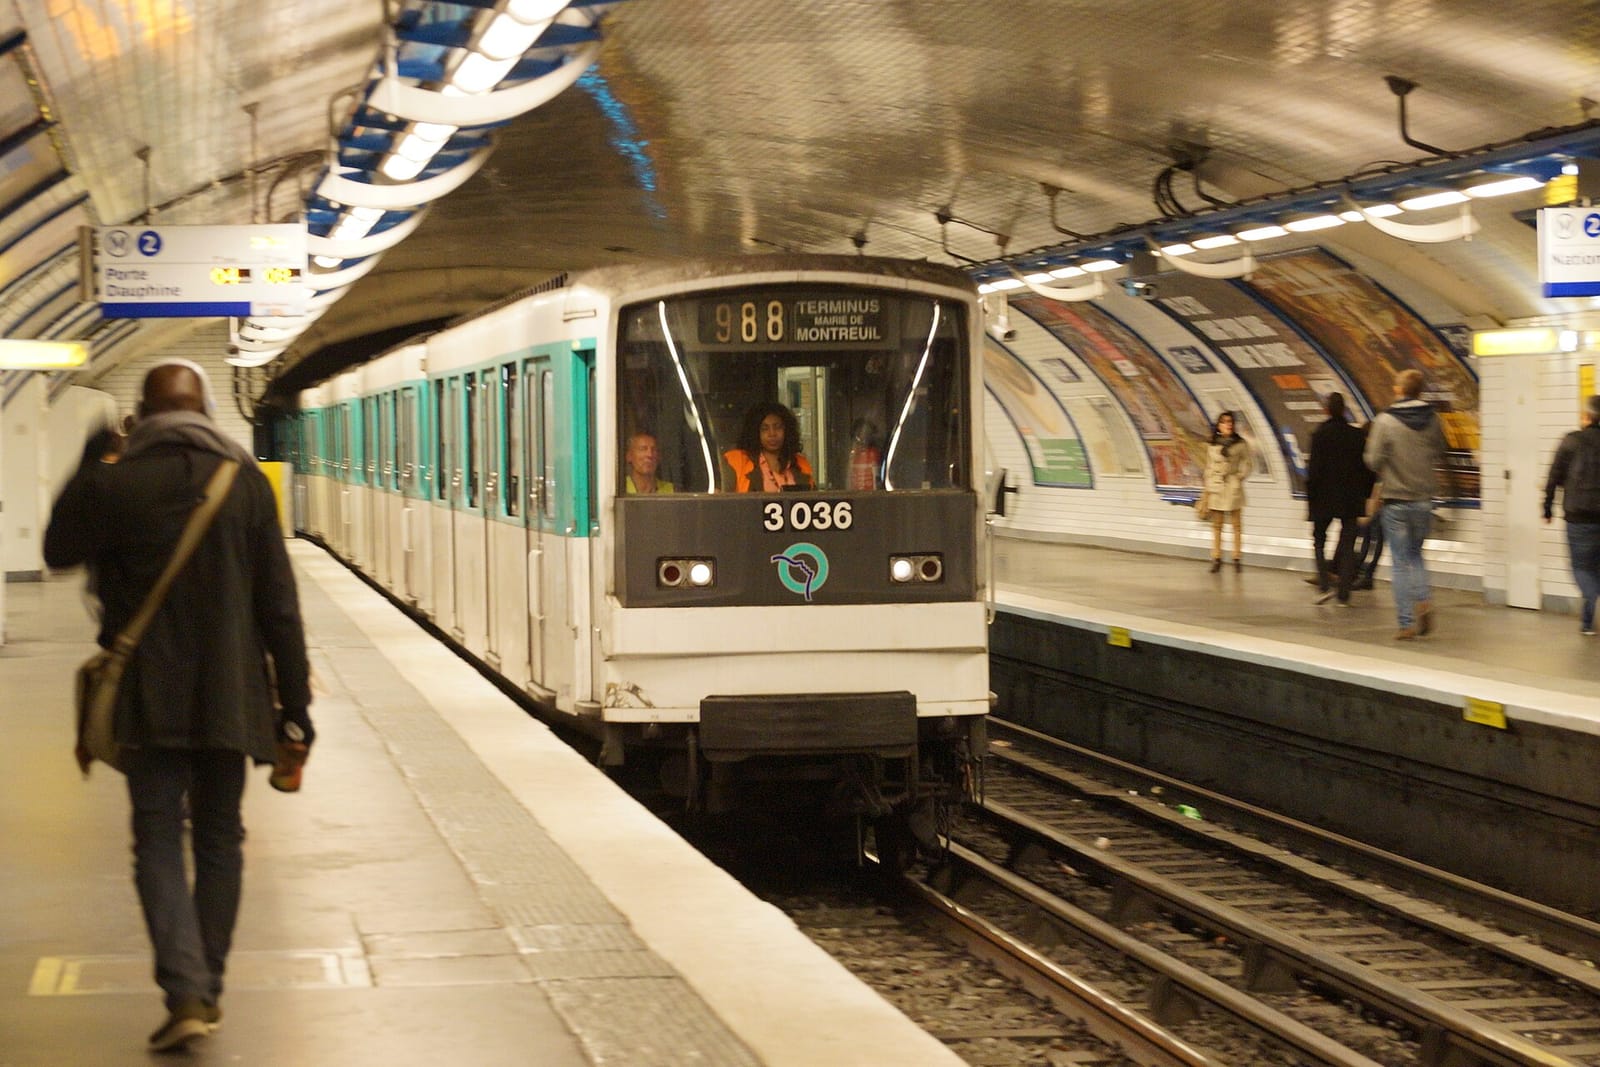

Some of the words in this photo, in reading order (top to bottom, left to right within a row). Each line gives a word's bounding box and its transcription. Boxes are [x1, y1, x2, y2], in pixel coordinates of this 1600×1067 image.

[141, 234, 159, 254] 2
[796, 299, 880, 315] TERMINUS
[814, 315, 848, 326] MAIRIE
[850, 315, 863, 325] DE
[796, 327, 881, 341] MONTREUIL
